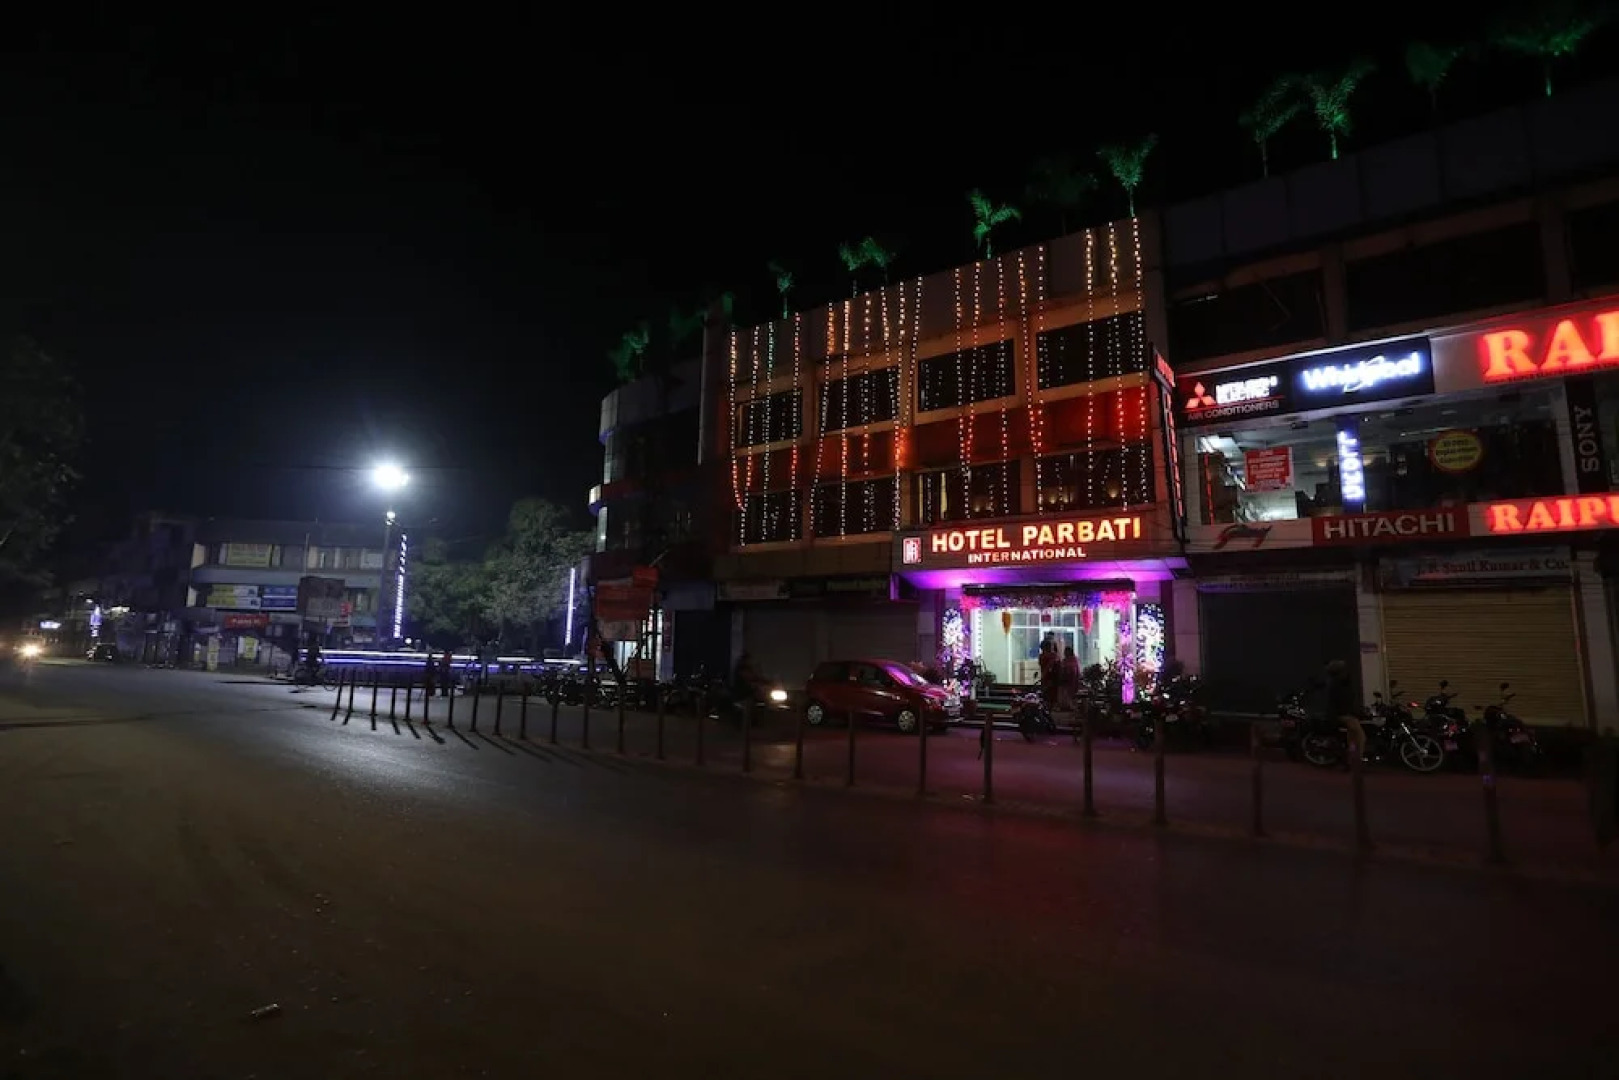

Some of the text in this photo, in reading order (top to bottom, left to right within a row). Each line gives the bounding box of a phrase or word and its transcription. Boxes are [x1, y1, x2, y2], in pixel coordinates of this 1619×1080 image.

[1205, 400, 1279, 418] CONDITIONERS
[1575, 405, 1600, 473] SONY
[932, 528, 1011, 553] HOTEL
[1022, 517, 1141, 546] PARBATI
[1324, 513, 1454, 539] HITACHI
[967, 546, 1087, 564] INTERNATIONAL
